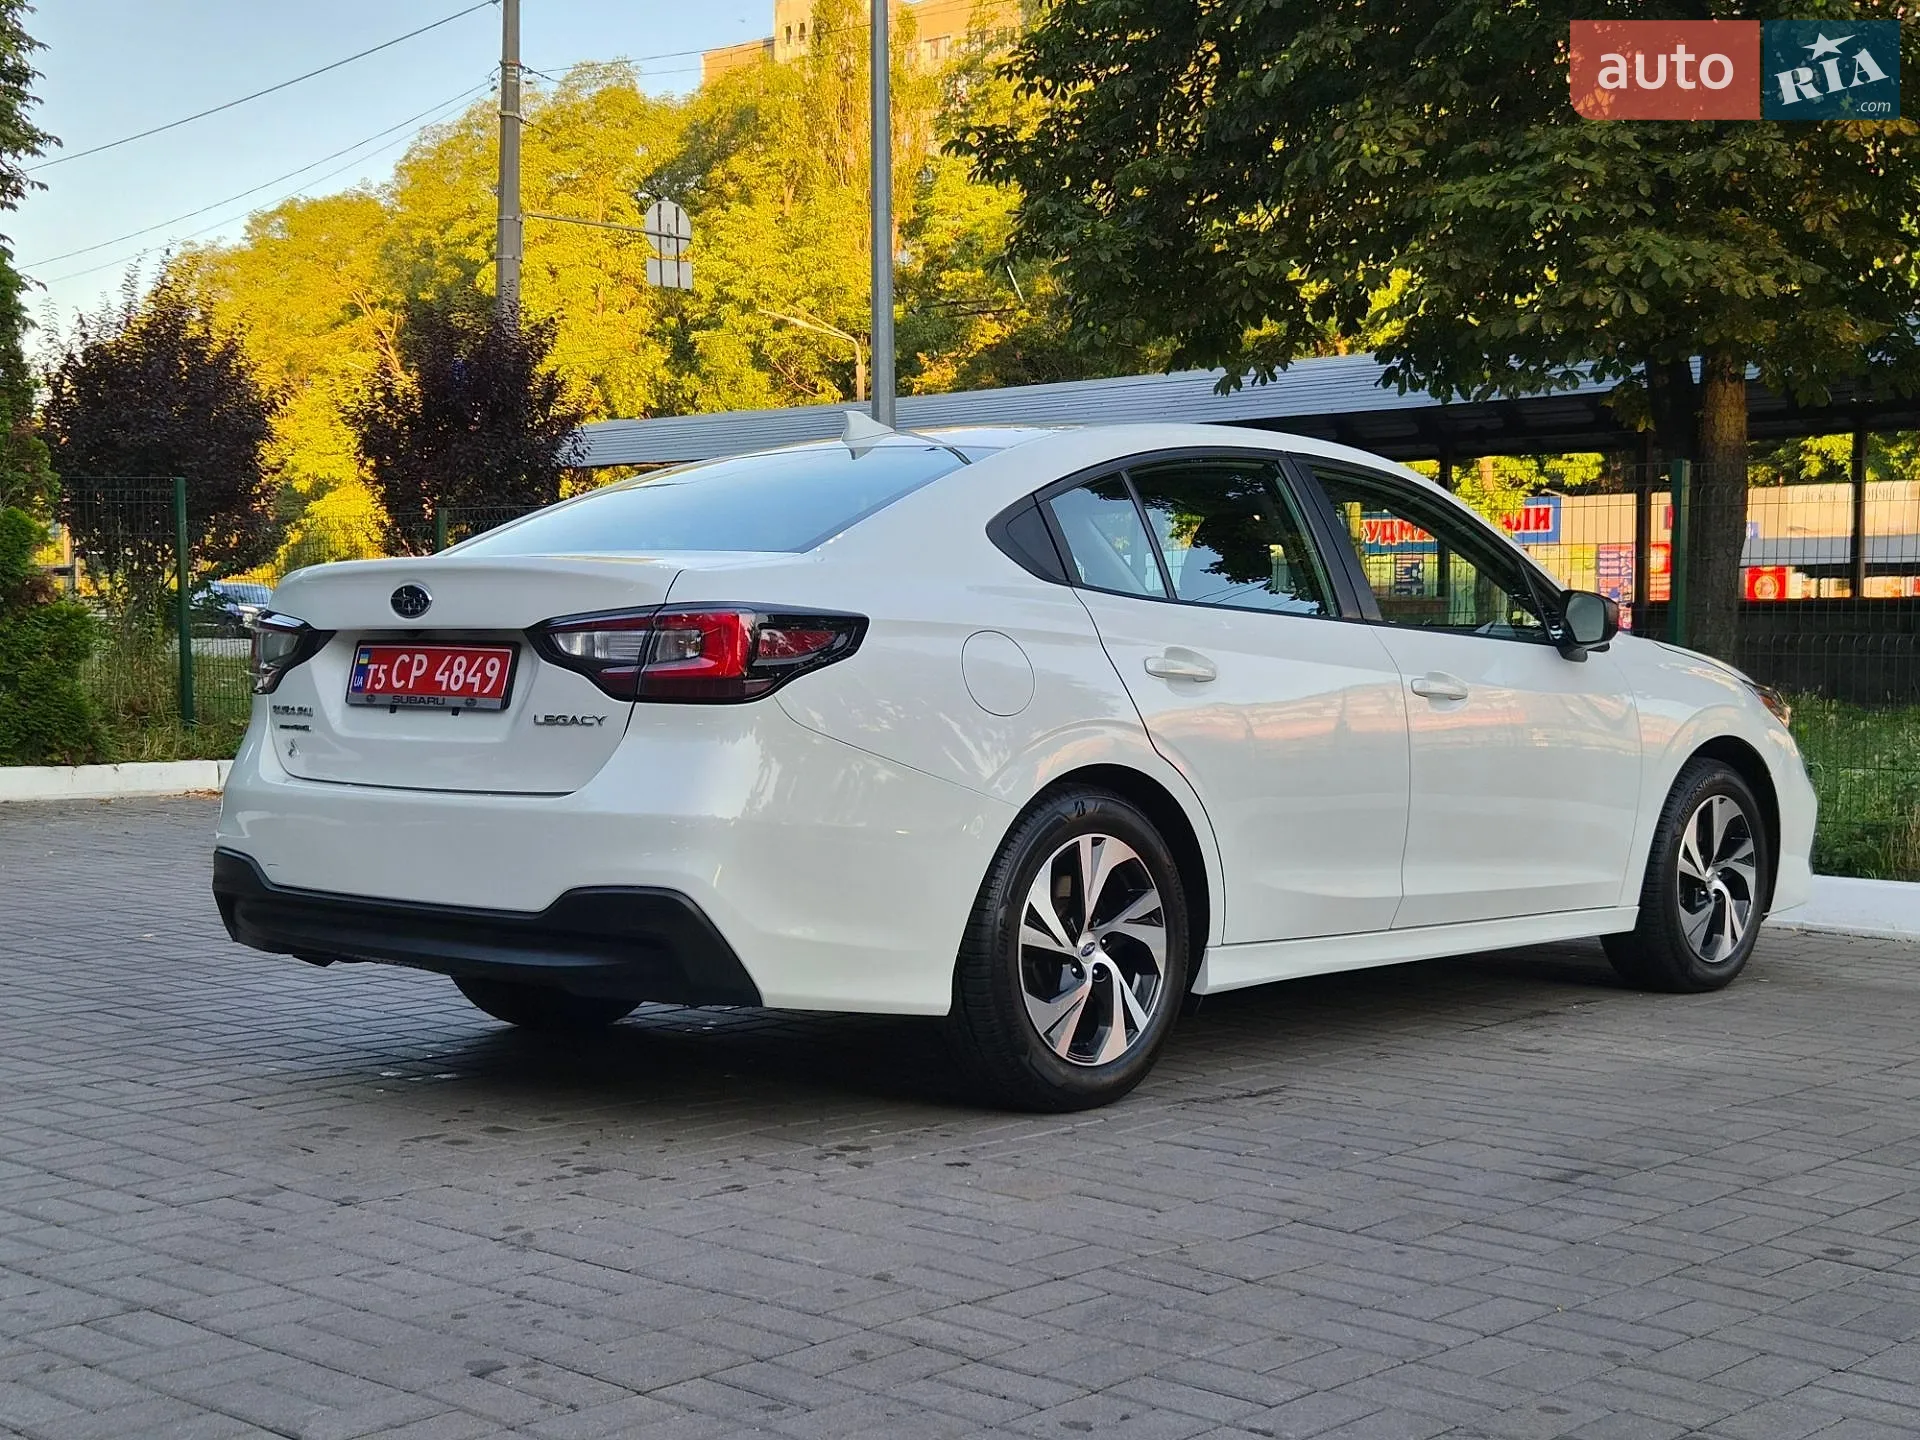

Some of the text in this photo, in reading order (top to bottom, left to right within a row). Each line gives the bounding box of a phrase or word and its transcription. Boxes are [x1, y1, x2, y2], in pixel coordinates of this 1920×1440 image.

[1360, 519, 1435, 545] УДМ
[366, 653, 501, 694] T5 CP 4849
[353, 675, 364, 688] UA
[391, 695, 446, 706] SUBARU
[533, 713, 608, 727] LEGACY
